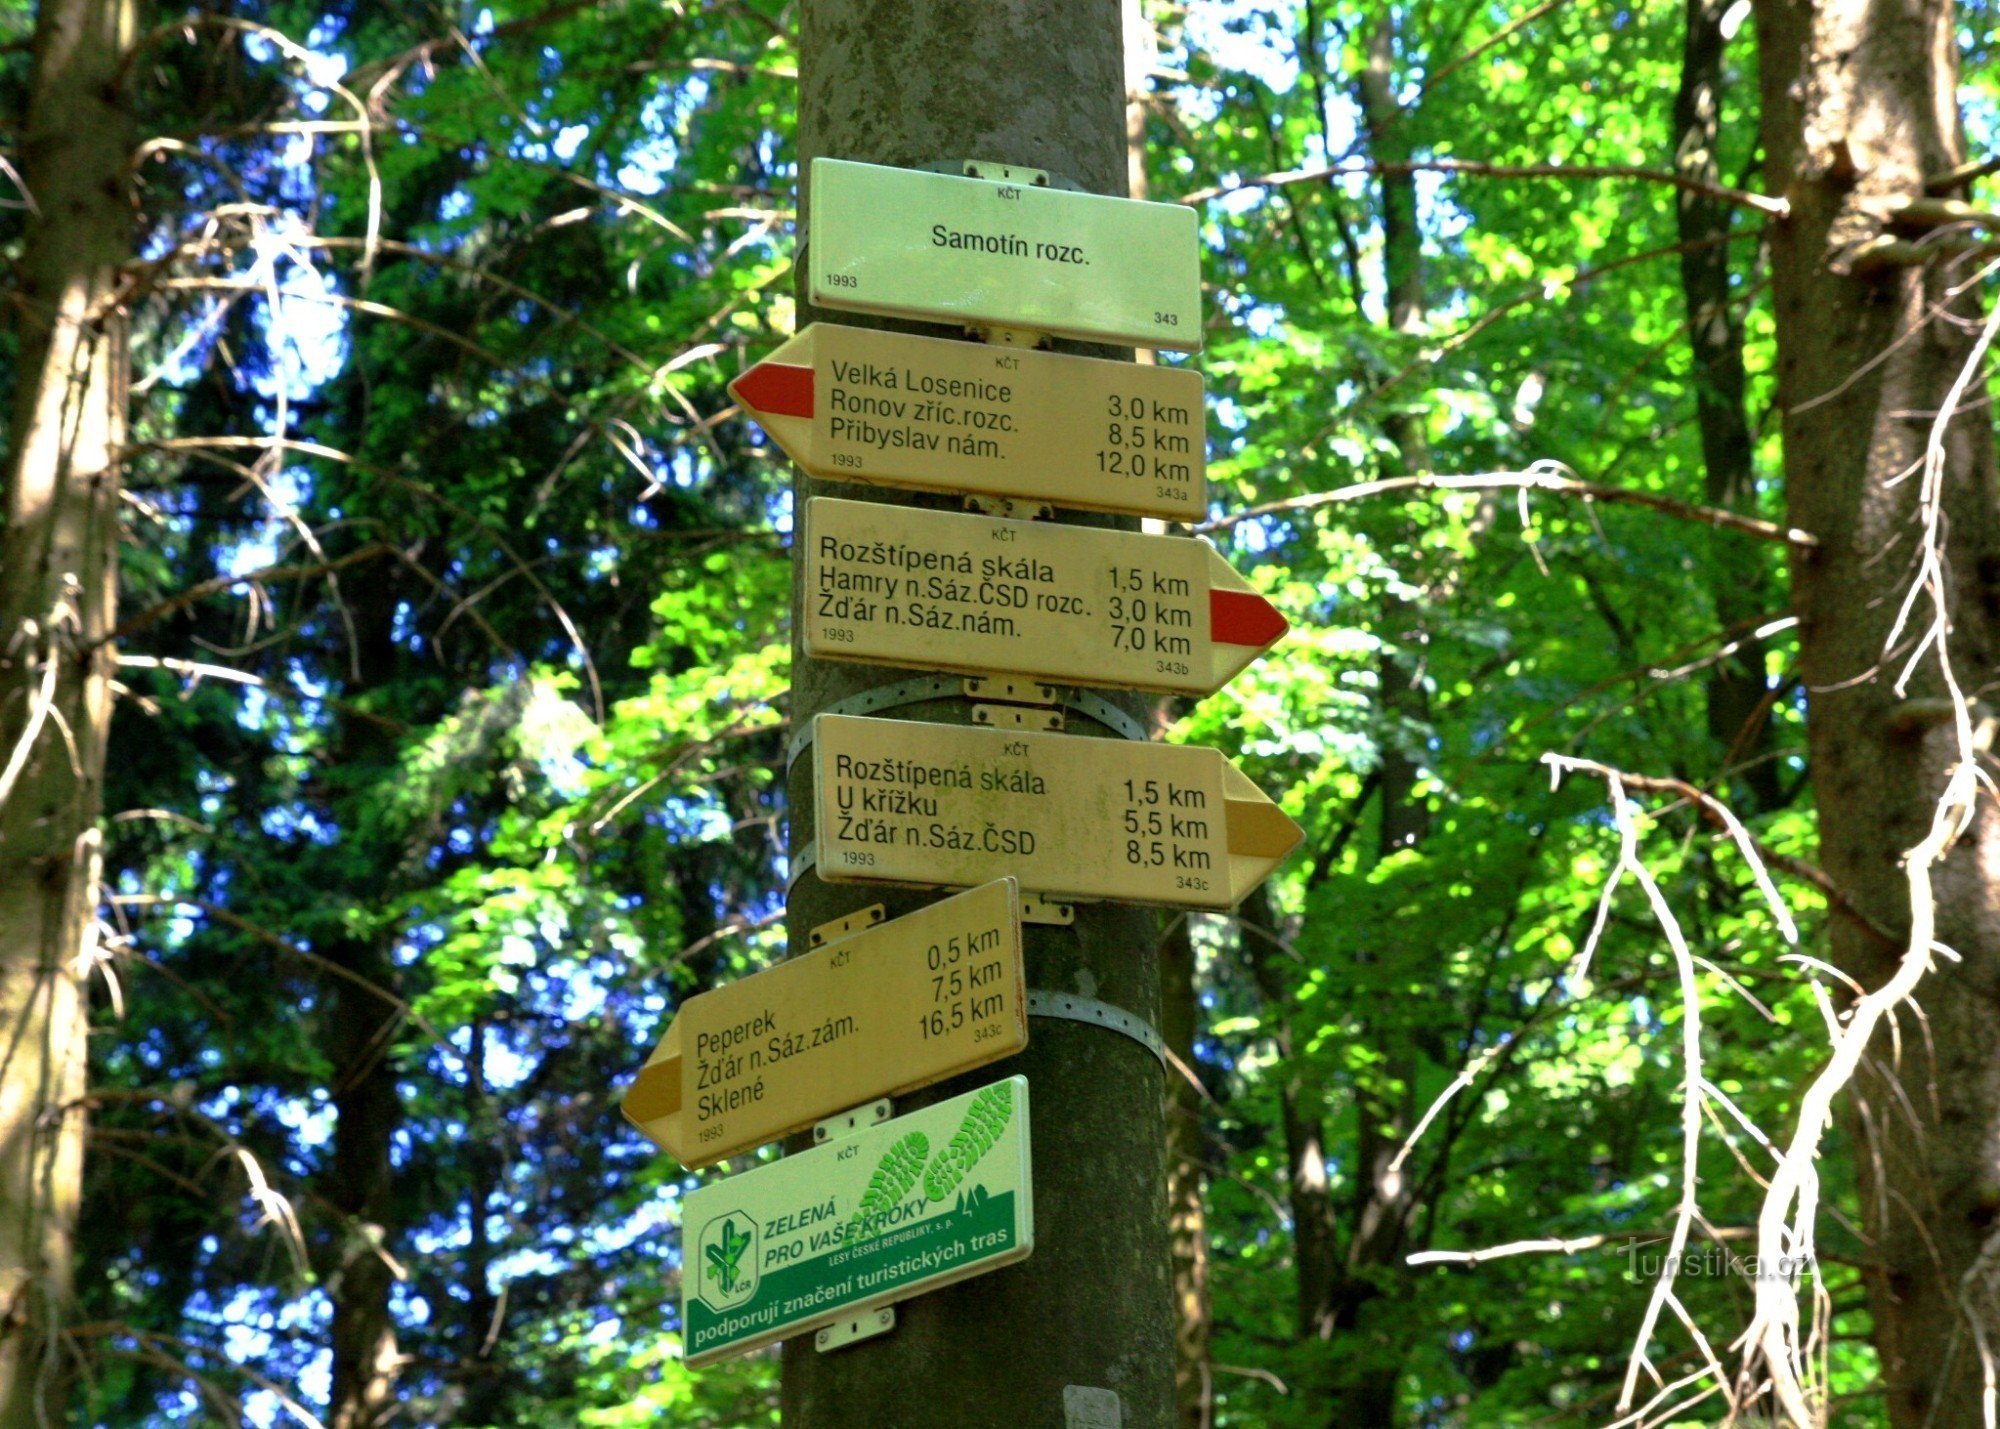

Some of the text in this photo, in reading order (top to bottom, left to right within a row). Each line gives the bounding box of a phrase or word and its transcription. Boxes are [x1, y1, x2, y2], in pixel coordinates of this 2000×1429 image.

[997, 186, 1021, 200] KČT
[932, 225, 1090, 265] Samotín rozc.
[827, 274, 857, 288] 1993
[1154, 312, 1178, 325] 343
[995, 355, 1019, 370] KČT
[832, 360, 1188, 424] Velká Losenice 3,0 km
[831, 389, 1189, 453] Ronov zříc.rozc. 8,5 km
[831, 416, 1189, 481] Přibyslav nám. 12,0 km
[831, 454, 862, 468] 1993
[1156, 486, 1187, 501] 343a
[992, 528, 1016, 542] KČT
[821, 536, 1188, 596] Rozštípená skála 1,5 km
[820, 566, 1191, 627] Hamry n.Sáz.ČSD rozc. 3,0 km
[819, 594, 1190, 655] Žďár n.Sáz.nám. 7,0 km
[823, 627, 854, 643] 1993
[1157, 660, 1188, 675] 343b
[1004, 743, 1030, 757] KČT
[836, 755, 1205, 808] Rozštípená skála 1,5 km
[836, 786, 1208, 839] U křížku 5,5 km
[838, 816, 1210, 869] Žďár n.Sáz.ČSD 8,5 km
[843, 851, 875, 866] 1993
[1176, 876, 1209, 891] 343c
[830, 950, 852, 969] KČT
[697, 926, 1000, 1058] Peperek 0,5 km
[697, 958, 1002, 1091] Žďár n.Sáz.zám. 7,5 km
[974, 1025, 1002, 1043] 343c
[698, 991, 1003, 1121] Sklené 16,5 km
[699, 1124, 723, 1143] 1993
[837, 1145, 859, 1161] KČT
[764, 1196, 836, 1240] ZELENÁ
[765, 1198, 930, 1267] PRO VAŠE KROKY
[829, 1251, 851, 1266] LESY
[695, 1228, 1007, 1346] podporují značení turistických tras
